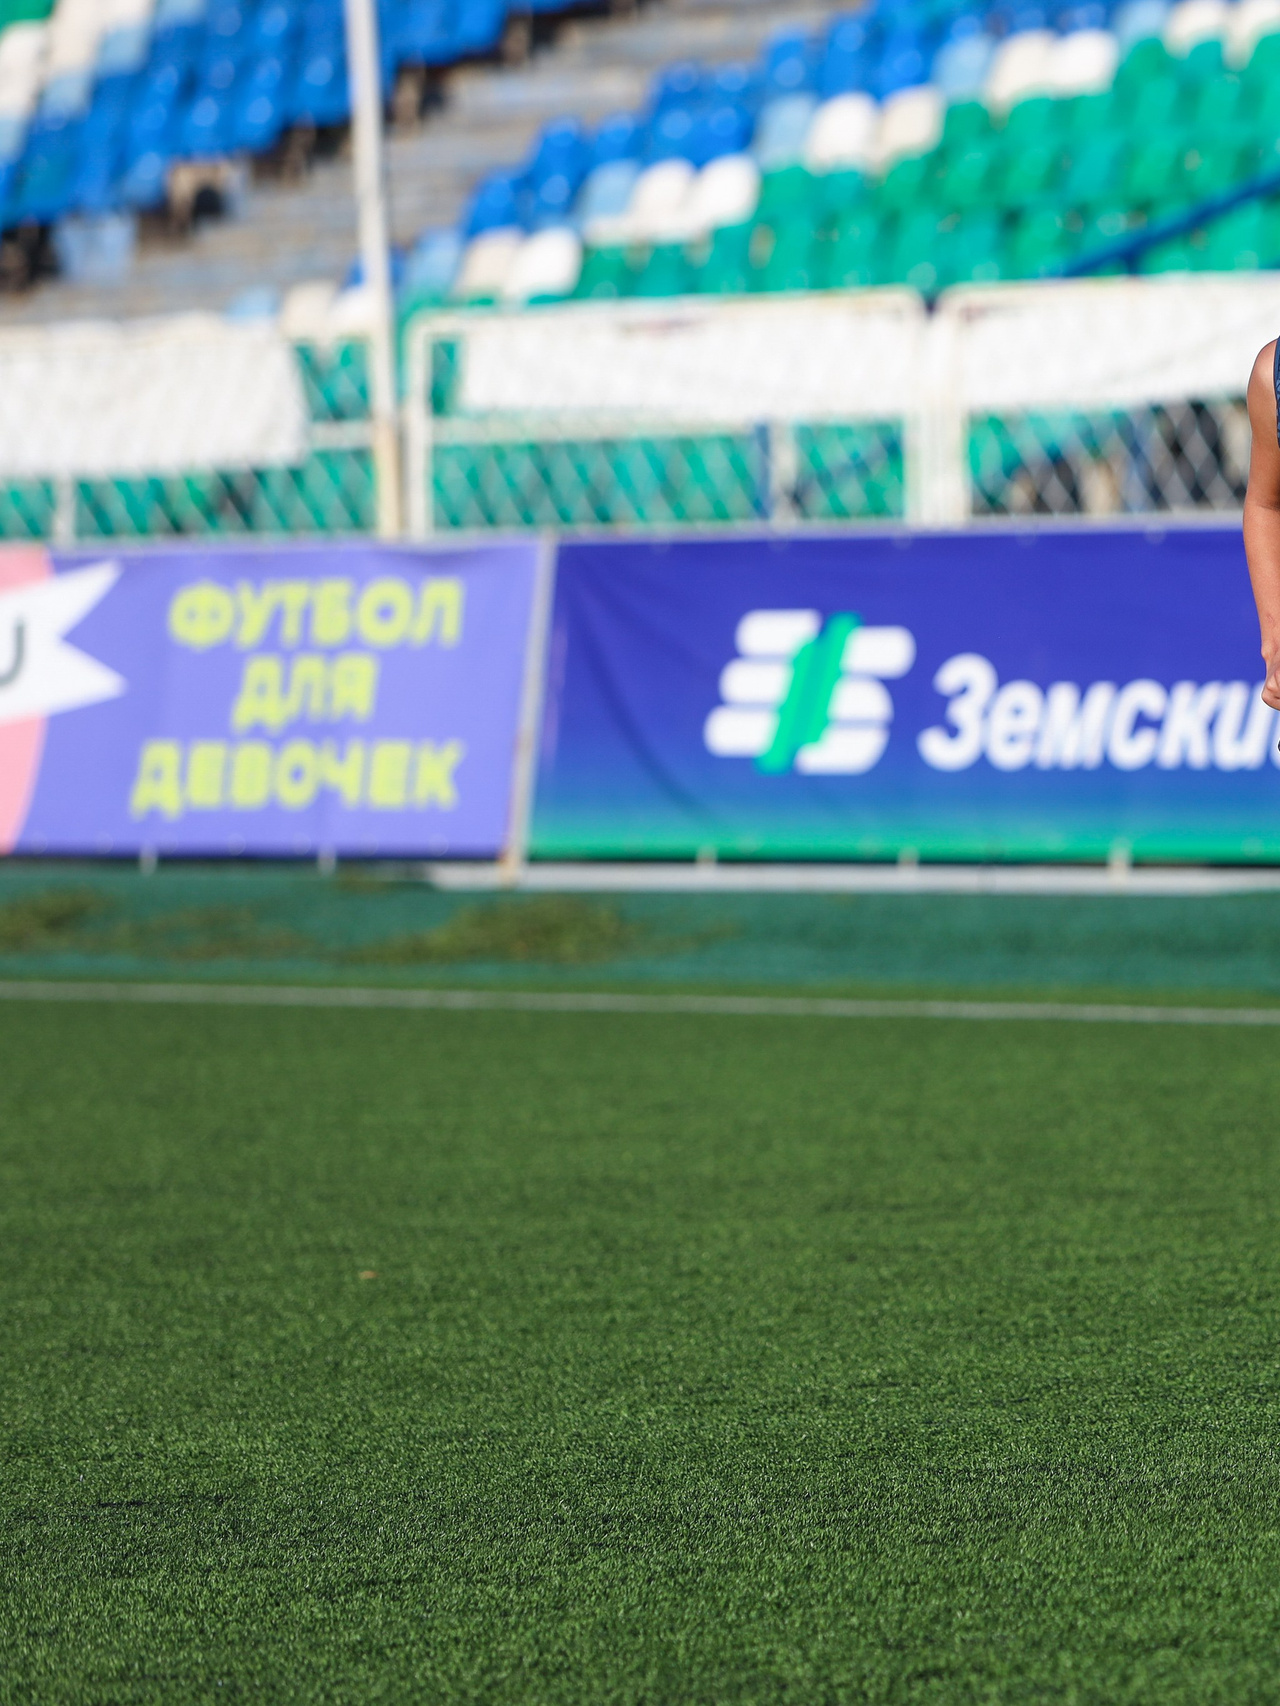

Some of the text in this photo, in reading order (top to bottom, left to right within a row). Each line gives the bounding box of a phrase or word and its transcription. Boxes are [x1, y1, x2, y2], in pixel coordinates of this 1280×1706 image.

[169, 577, 464, 652] ФУТБОЛ
[231, 652, 379, 734] ДЛЯ
[130, 738, 463, 820] ДЕВОЧЕК
